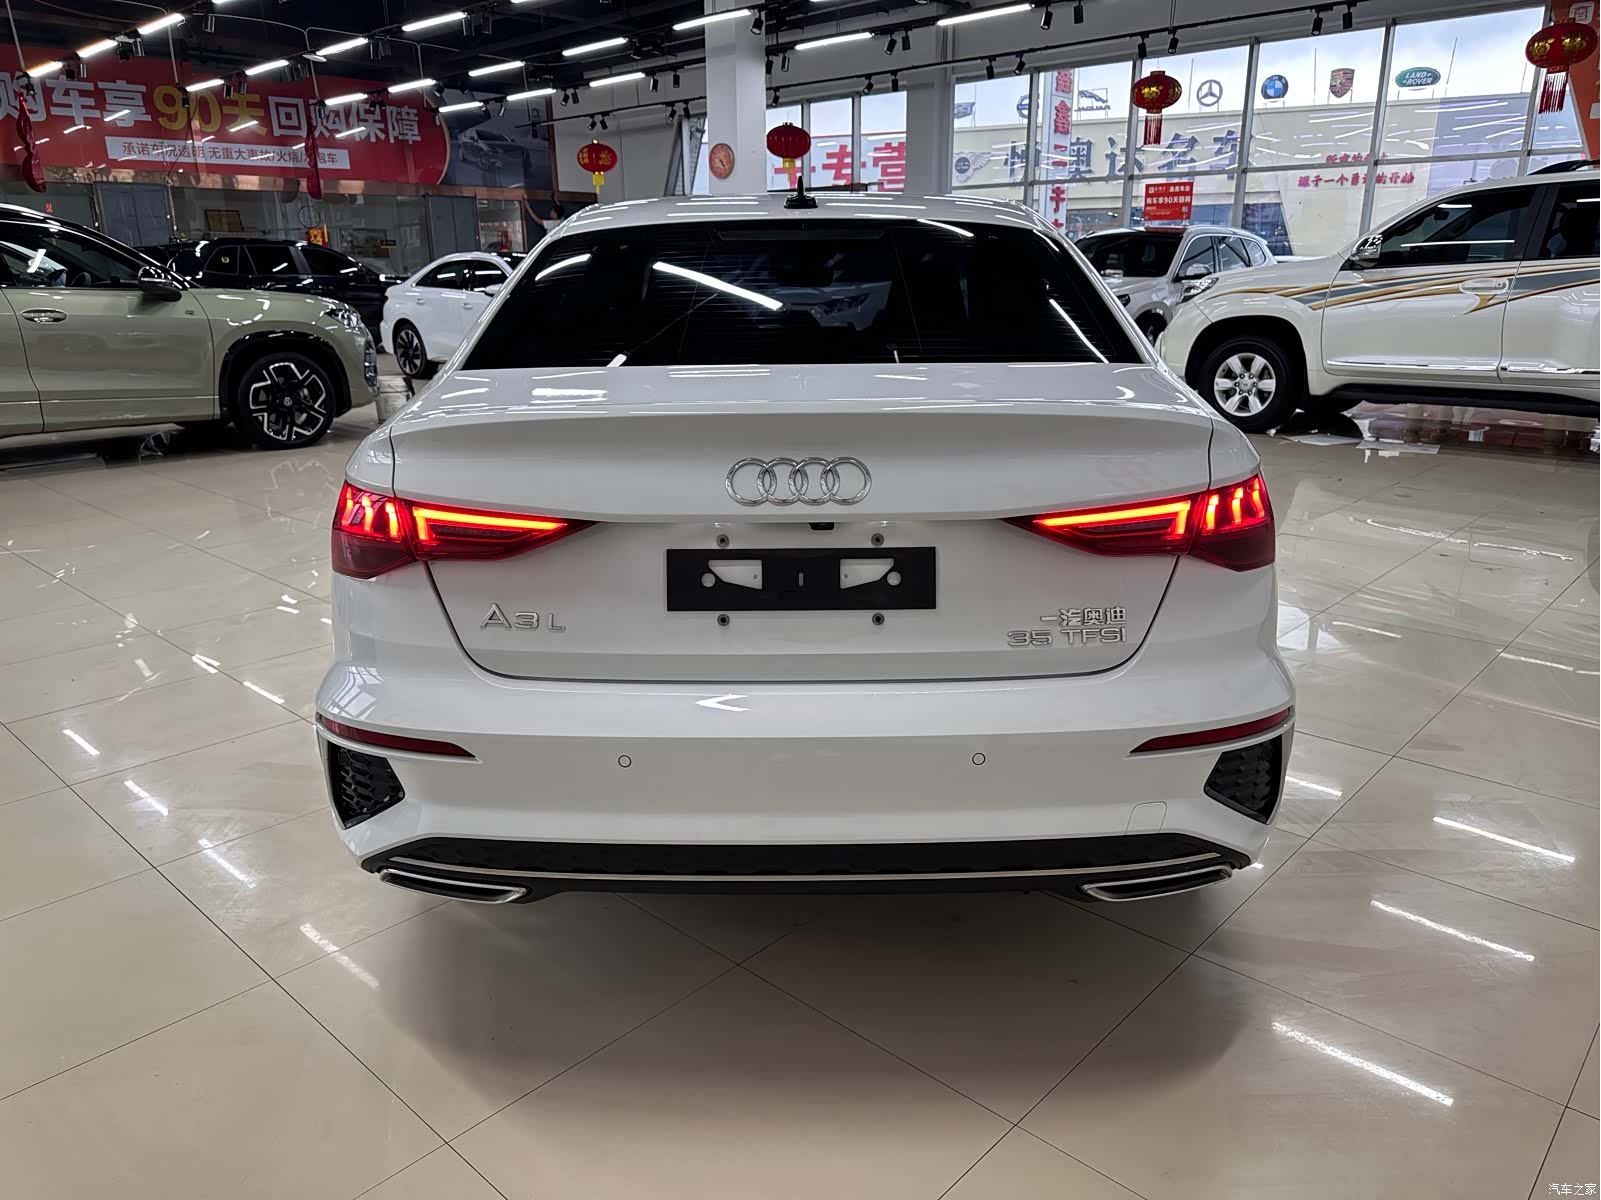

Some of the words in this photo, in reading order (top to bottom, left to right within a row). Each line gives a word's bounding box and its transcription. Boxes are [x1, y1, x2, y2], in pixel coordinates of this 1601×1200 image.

[121, 141, 205, 160] 承诺车况透明
[1040, 606, 1126, 627] 一汽奥迪
[1008, 630, 1053, 646] 35
[1060, 627, 1126, 644] TFSI
